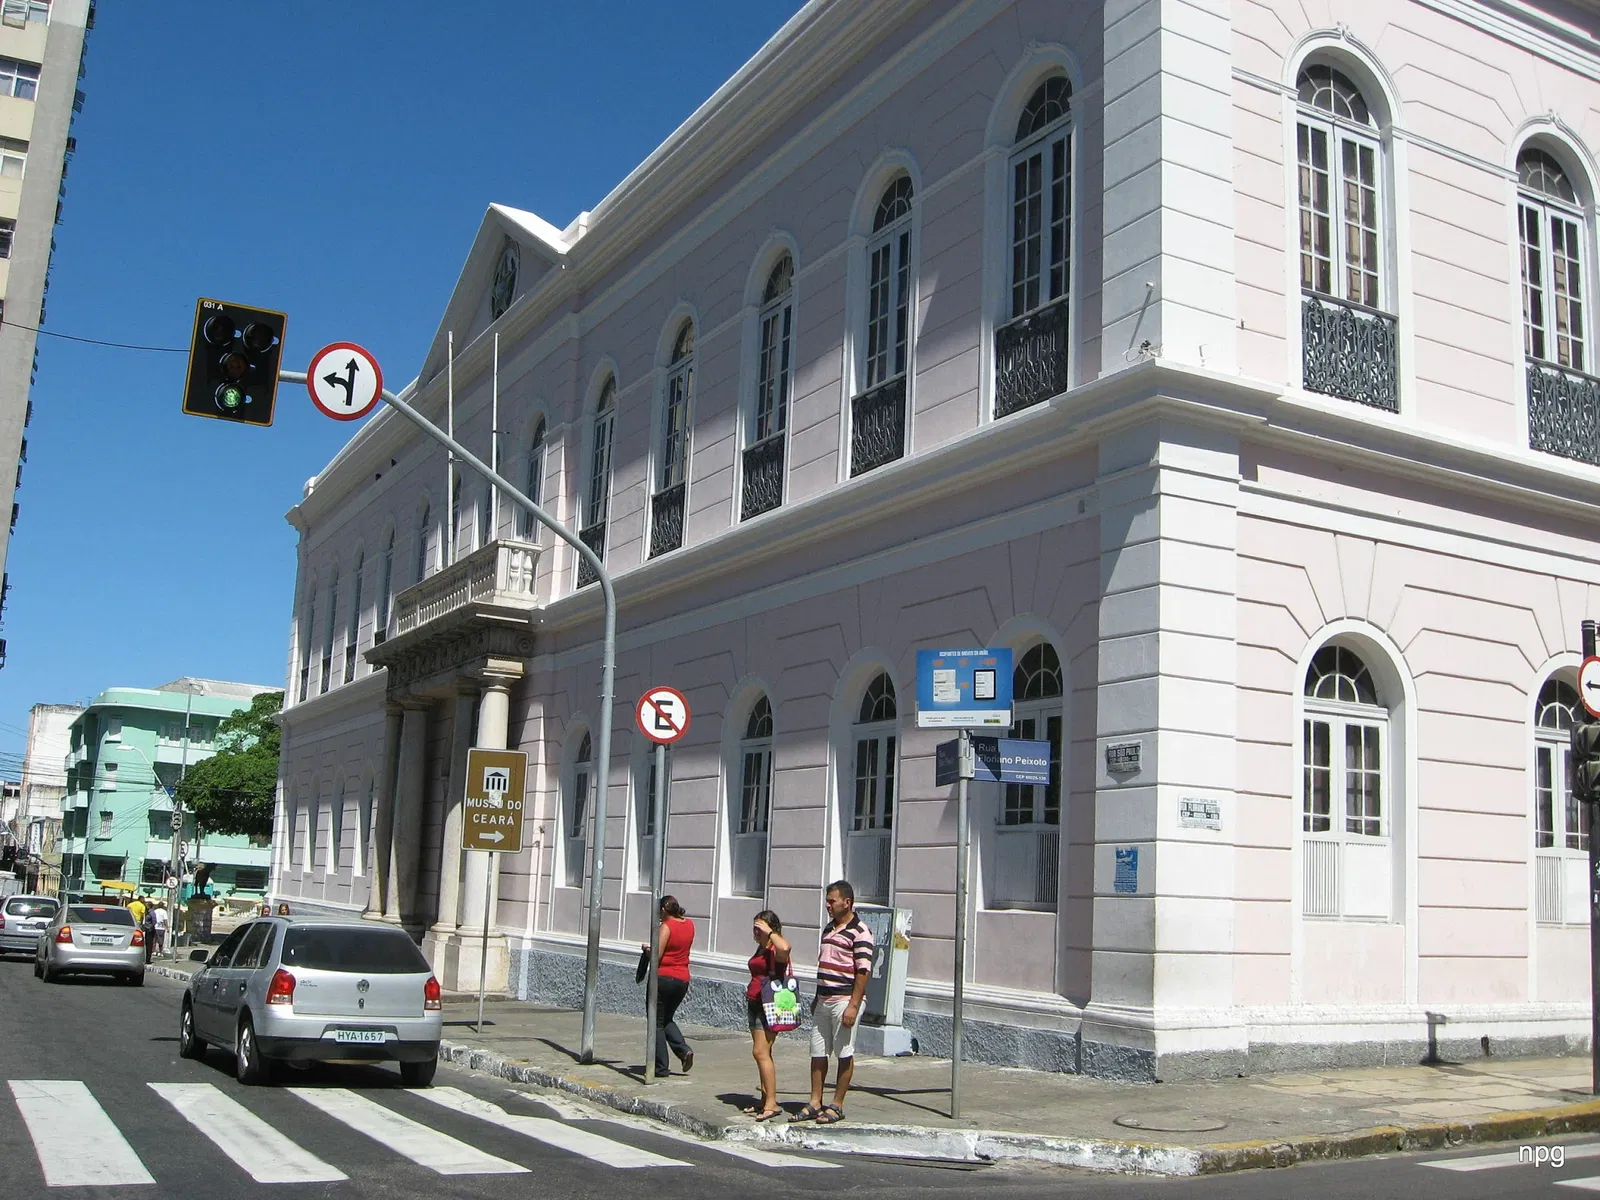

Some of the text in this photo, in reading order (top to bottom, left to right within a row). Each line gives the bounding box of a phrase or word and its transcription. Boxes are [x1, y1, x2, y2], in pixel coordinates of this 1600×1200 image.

[203, 301, 224, 311] 031 A
[978, 743, 996, 752] Rua
[978, 754, 1048, 766] Floriano Peixoto
[508, 800, 522, 810] DO
[472, 812, 514, 826] CEARÁ
